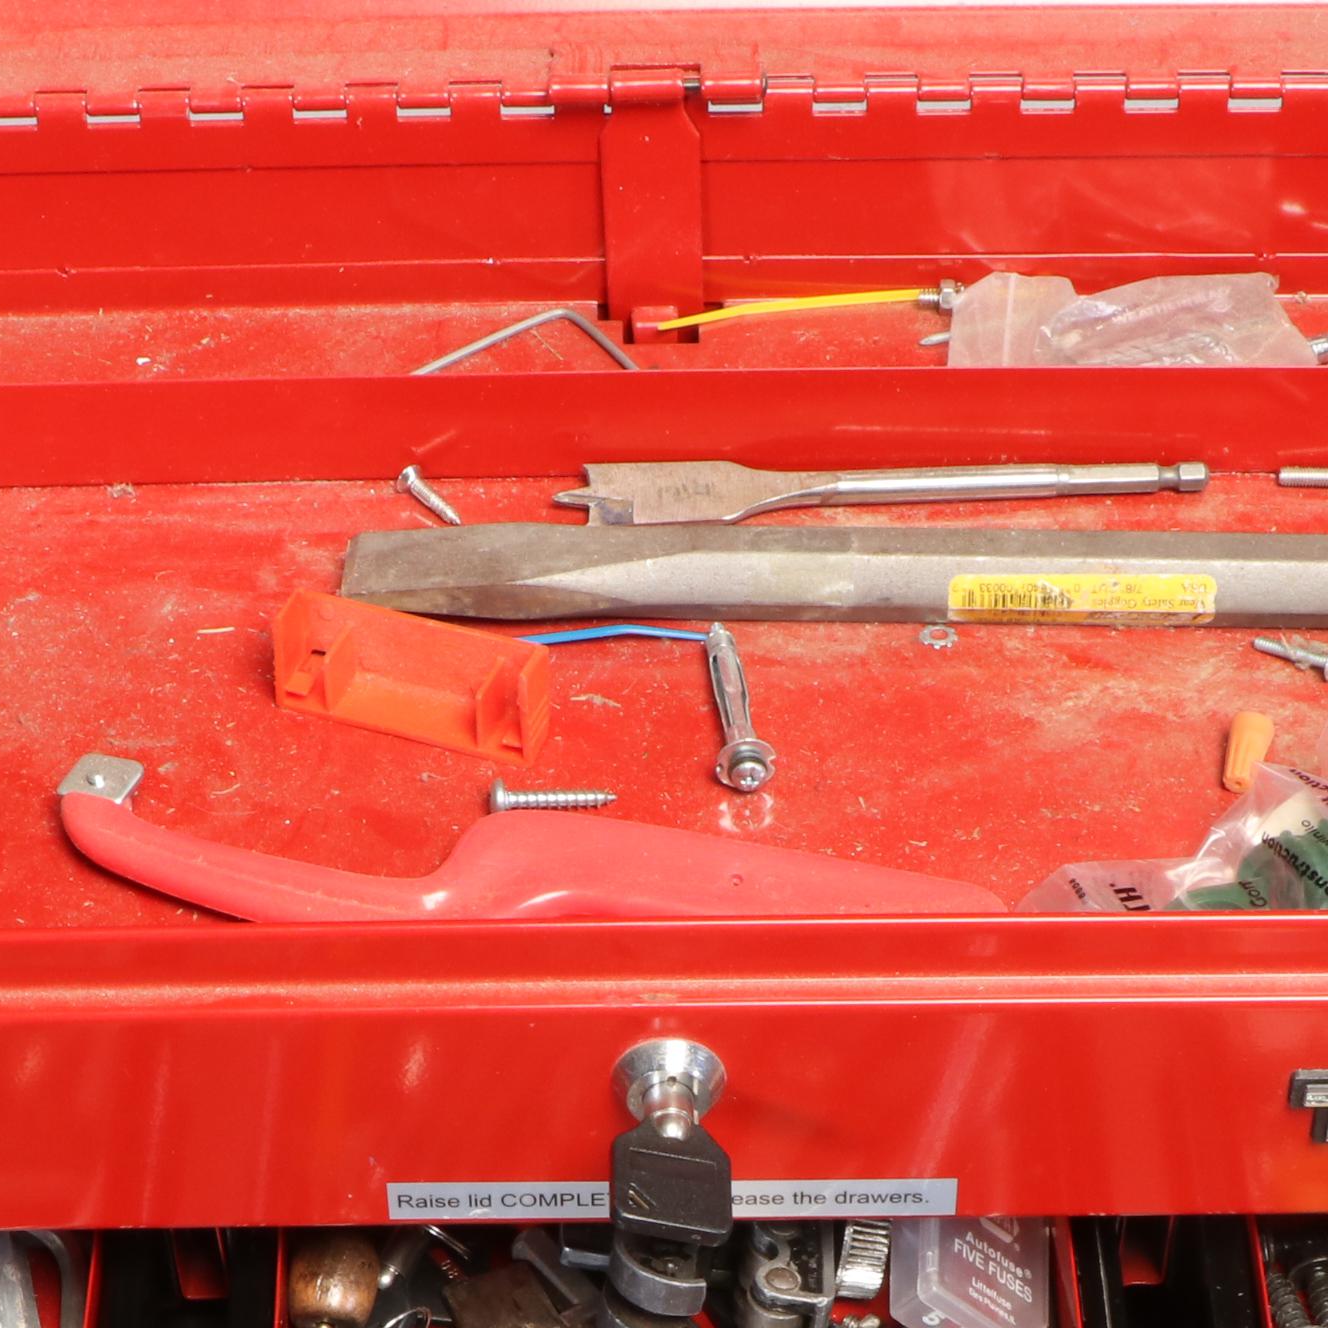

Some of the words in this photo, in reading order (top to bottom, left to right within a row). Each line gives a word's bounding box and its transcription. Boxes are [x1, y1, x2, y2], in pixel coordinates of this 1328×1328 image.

[397, 1193, 461, 1210] Raise
[468, 1192, 492, 1208] lid
[732, 1194, 785, 1207] ease
[792, 1190, 825, 1205] the
[835, 1189, 929, 1205] drawers.
[951, 1238, 985, 1270] FIVE
[986, 1261, 1034, 1303] FUSES
[920, 1308, 945, 1328] 5
